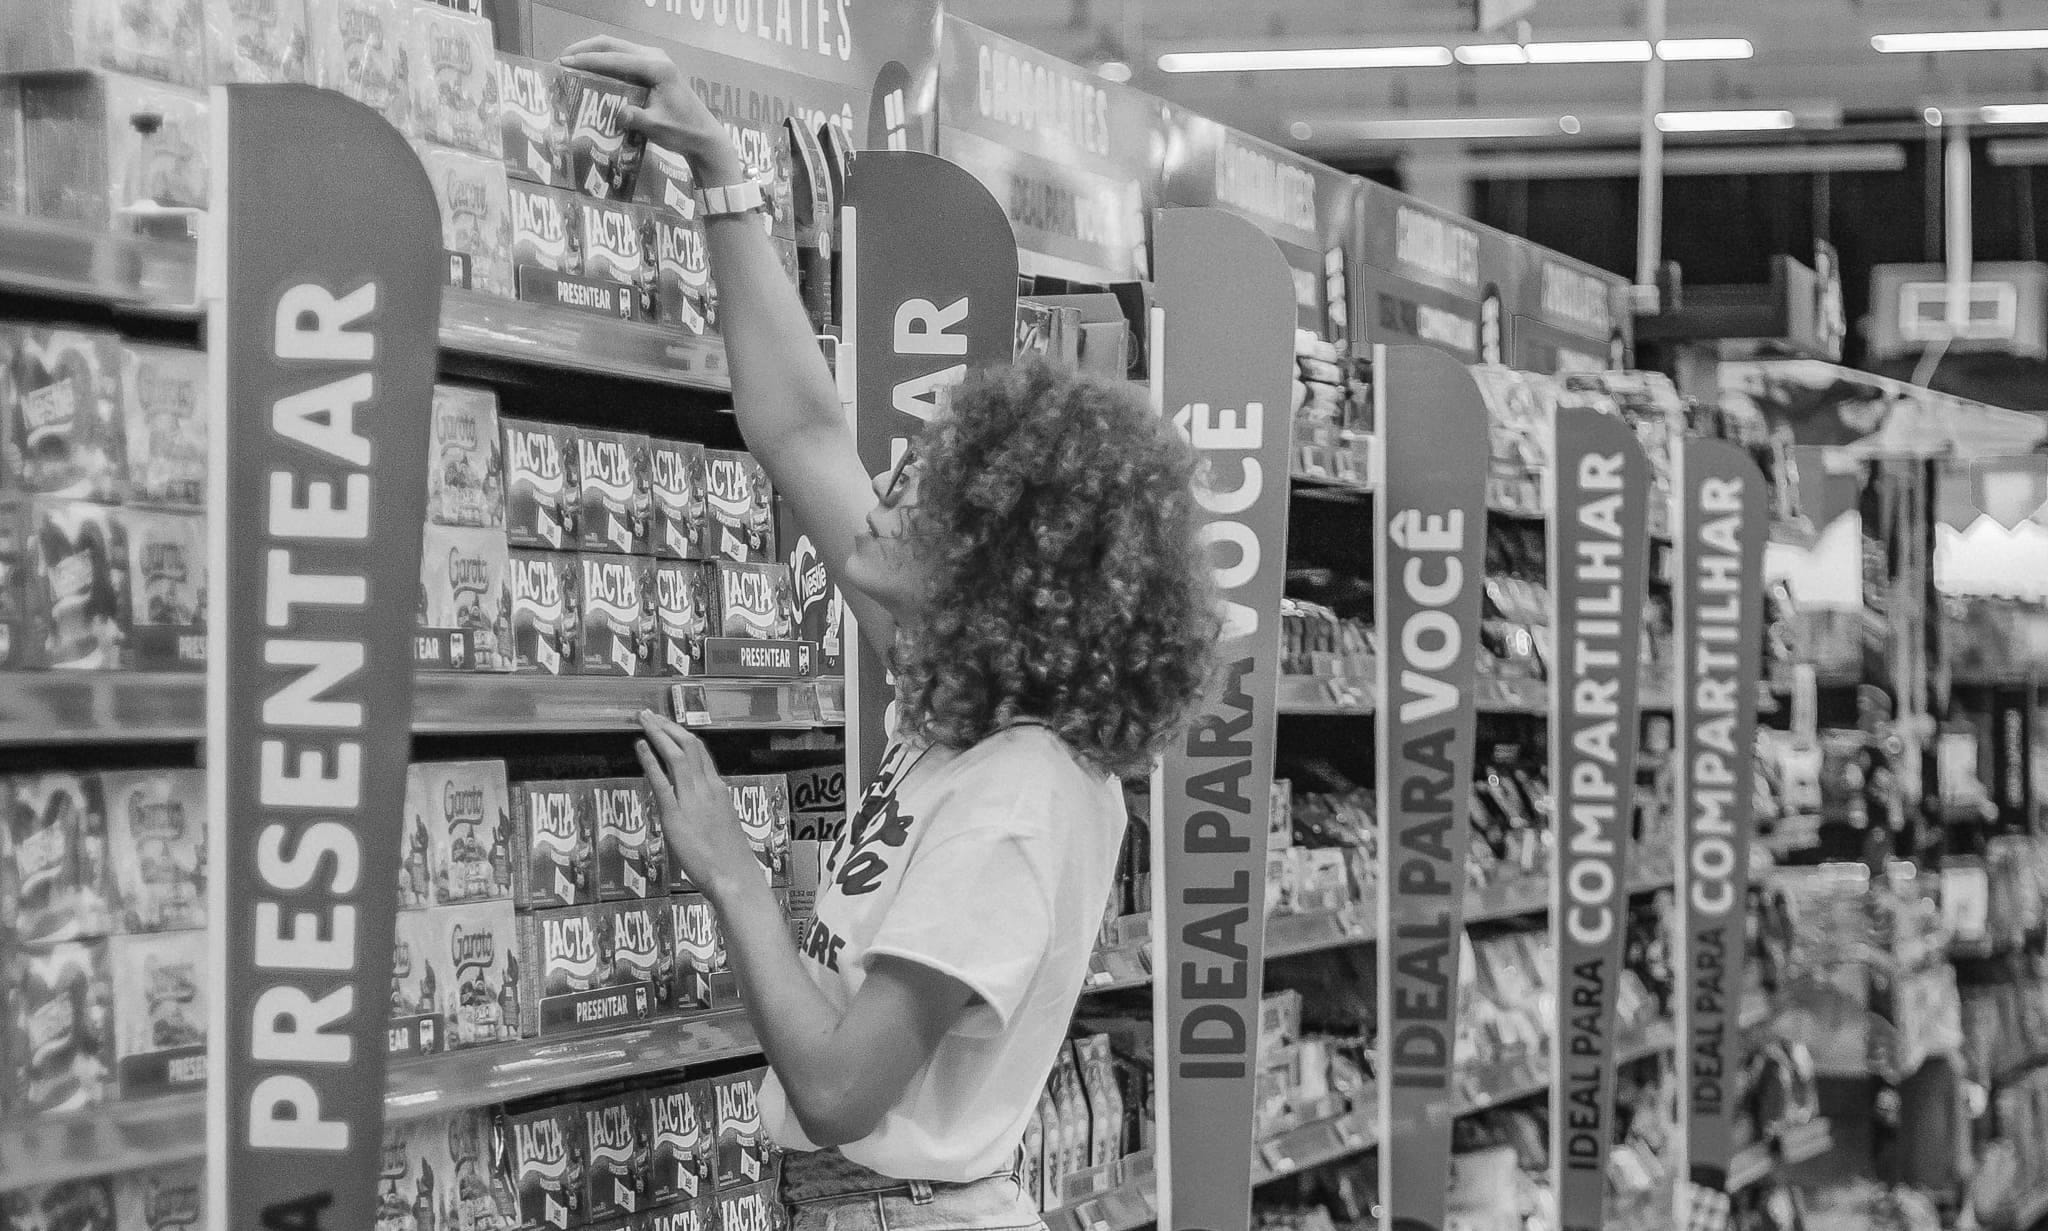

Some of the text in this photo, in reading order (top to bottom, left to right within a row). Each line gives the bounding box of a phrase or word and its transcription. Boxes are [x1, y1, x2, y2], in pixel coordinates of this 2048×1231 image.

[509, 188, 564, 245] LACTA
[583, 205, 639, 261] LACTA
[655, 220, 707, 273] LACTA
[557, 279, 612, 311] PRESENTEAR
[507, 428, 561, 487] LACTA
[578, 438, 631, 493] LACTA
[510, 558, 560, 615] LACTA
[582, 560, 637, 614] LACTA
[656, 569, 689, 611] CTA
[722, 569, 774, 620] LACTA
[741, 647, 791, 668] PRESENTEAR
[248, 281, 377, 1151] PRESENTEAR
[1566, 450, 1625, 944] COMPARTILHAR
[1690, 475, 1744, 916] COMPARTILHAR
[530, 791, 575, 848] LACTA
[594, 788, 644, 842] LACTA
[731, 785, 770, 825] ACTA
[1388, 508, 1465, 1090] IDEAL PARA VOCÊ
[543, 915, 595, 976] LACTA
[614, 910, 655, 952] ACTA
[671, 904, 713, 957] LACTA
[1179, 870, 1250, 1079] IDEAL
[576, 994, 628, 1023] PRESENTEAR
[1694, 927, 1725, 1115] IDEAL PARA
[1567, 959, 1603, 1171] IDEAL PARA
[586, 1104, 633, 1167] LACTA
[651, 1092, 697, 1150] LACTA
[715, 1080, 760, 1137] LACTA
[513, 1118, 565, 1181] LACTA
